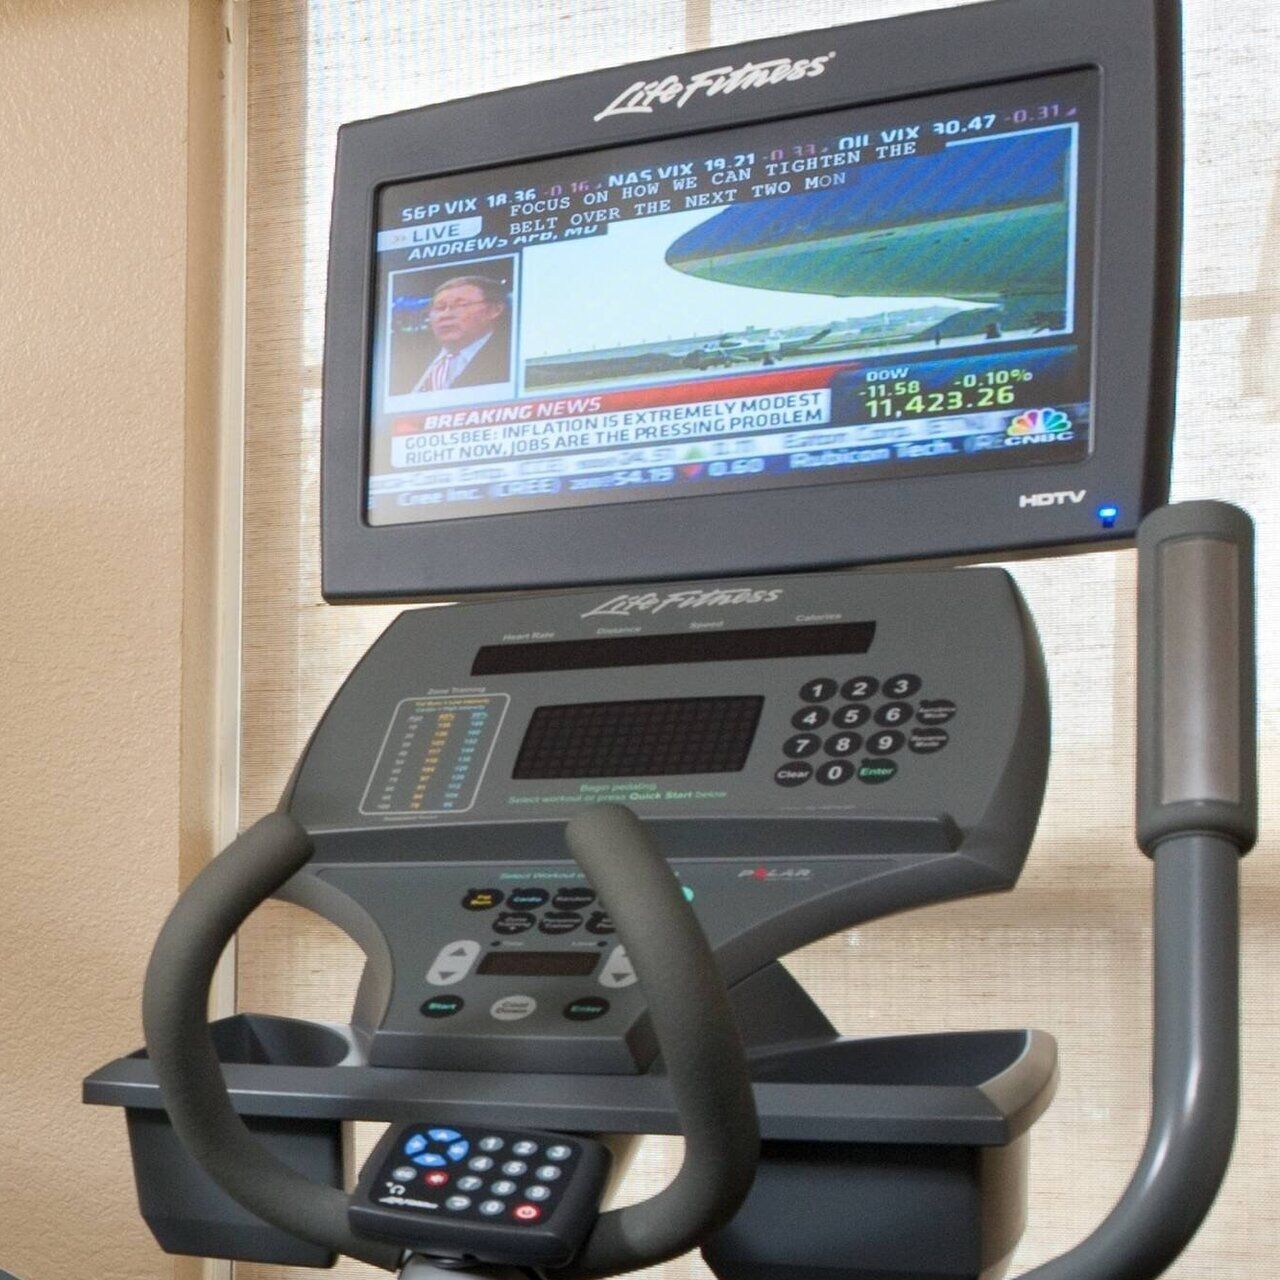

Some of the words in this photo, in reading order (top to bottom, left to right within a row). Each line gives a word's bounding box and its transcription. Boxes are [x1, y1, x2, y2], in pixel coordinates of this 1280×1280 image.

[593, 75, 683, 122] Life
[676, 57, 830, 108] Fitness
[401, 203, 440, 222] S&P
[444, 197, 478, 216] VIX
[607, 169, 653, 188] NAS
[656, 162, 695, 180] VIX
[880, 126, 921, 144] VIX
[932, 114, 997, 136] 30.47
[508, 197, 572, 218] FOCUS
[583, 190, 609, 206] ON
[621, 182, 659, 200] HOW
[672, 176, 698, 191] WE
[711, 167, 752, 186] CAN
[764, 150, 861, 177] TIGHTEN
[875, 141, 917, 160] THE
[509, 216, 558, 236] BELT
[569, 206, 621, 227] OVER
[633, 198, 672, 217] THE
[684, 188, 738, 208] NEXT
[751, 180, 792, 198] TWO
[804, 171, 846, 192] MON
[411, 223, 461, 244] LIVE
[407, 235, 508, 262] ANDREWS
[866, 366, 910, 383] DOW
[859, 379, 920, 399] -11.58
[954, 367, 1033, 389] -0.10%
[865, 384, 1016, 420] 11,423.26
[404, 428, 498, 451] GOOLSBEE:
[502, 415, 598, 439] INFLATION
[603, 412, 619, 428] IS
[623, 401, 737, 427] EXTREMELY
[740, 391, 822, 415] MODEST
[423, 403, 532, 431] BREAKING
[536, 396, 603, 417] NEWS
[405, 447, 455, 466] RIGHT
[459, 439, 507, 461] NOW,
[510, 435, 550, 456] JOBS
[553, 432, 590, 450] ARE
[595, 427, 631, 445] THE
[634, 415, 726, 441] PRESSING
[729, 407, 823, 432] PROBLEM
[1004, 431, 1075, 447] CNBC
[1019, 489, 1087, 509] HDTV
[581, 592, 660, 619] Life
[652, 588, 783, 615] Fitness
[812, 684, 824, 698] 1
[851, 682, 868, 697] 2
[893, 679, 909, 695] 3
[803, 711, 818, 725] 4
[844, 709, 860, 724] 5
[885, 707, 901, 721] 6
[796, 739, 810, 754] 7
[835, 737, 851, 752] 8
[878, 735, 894, 750] 9
[776, 768, 810, 779] Clear
[827, 766, 843, 781] 0
[859, 765, 895, 777] Enter
[580, 783, 611, 793] Begin
[508, 795, 541, 805] Select
[541, 793, 582, 804] workout
[598, 792, 627, 803] press
[629, 790, 662, 801] Quick
[665, 790, 693, 801] Start
[695, 790, 728, 800] below
